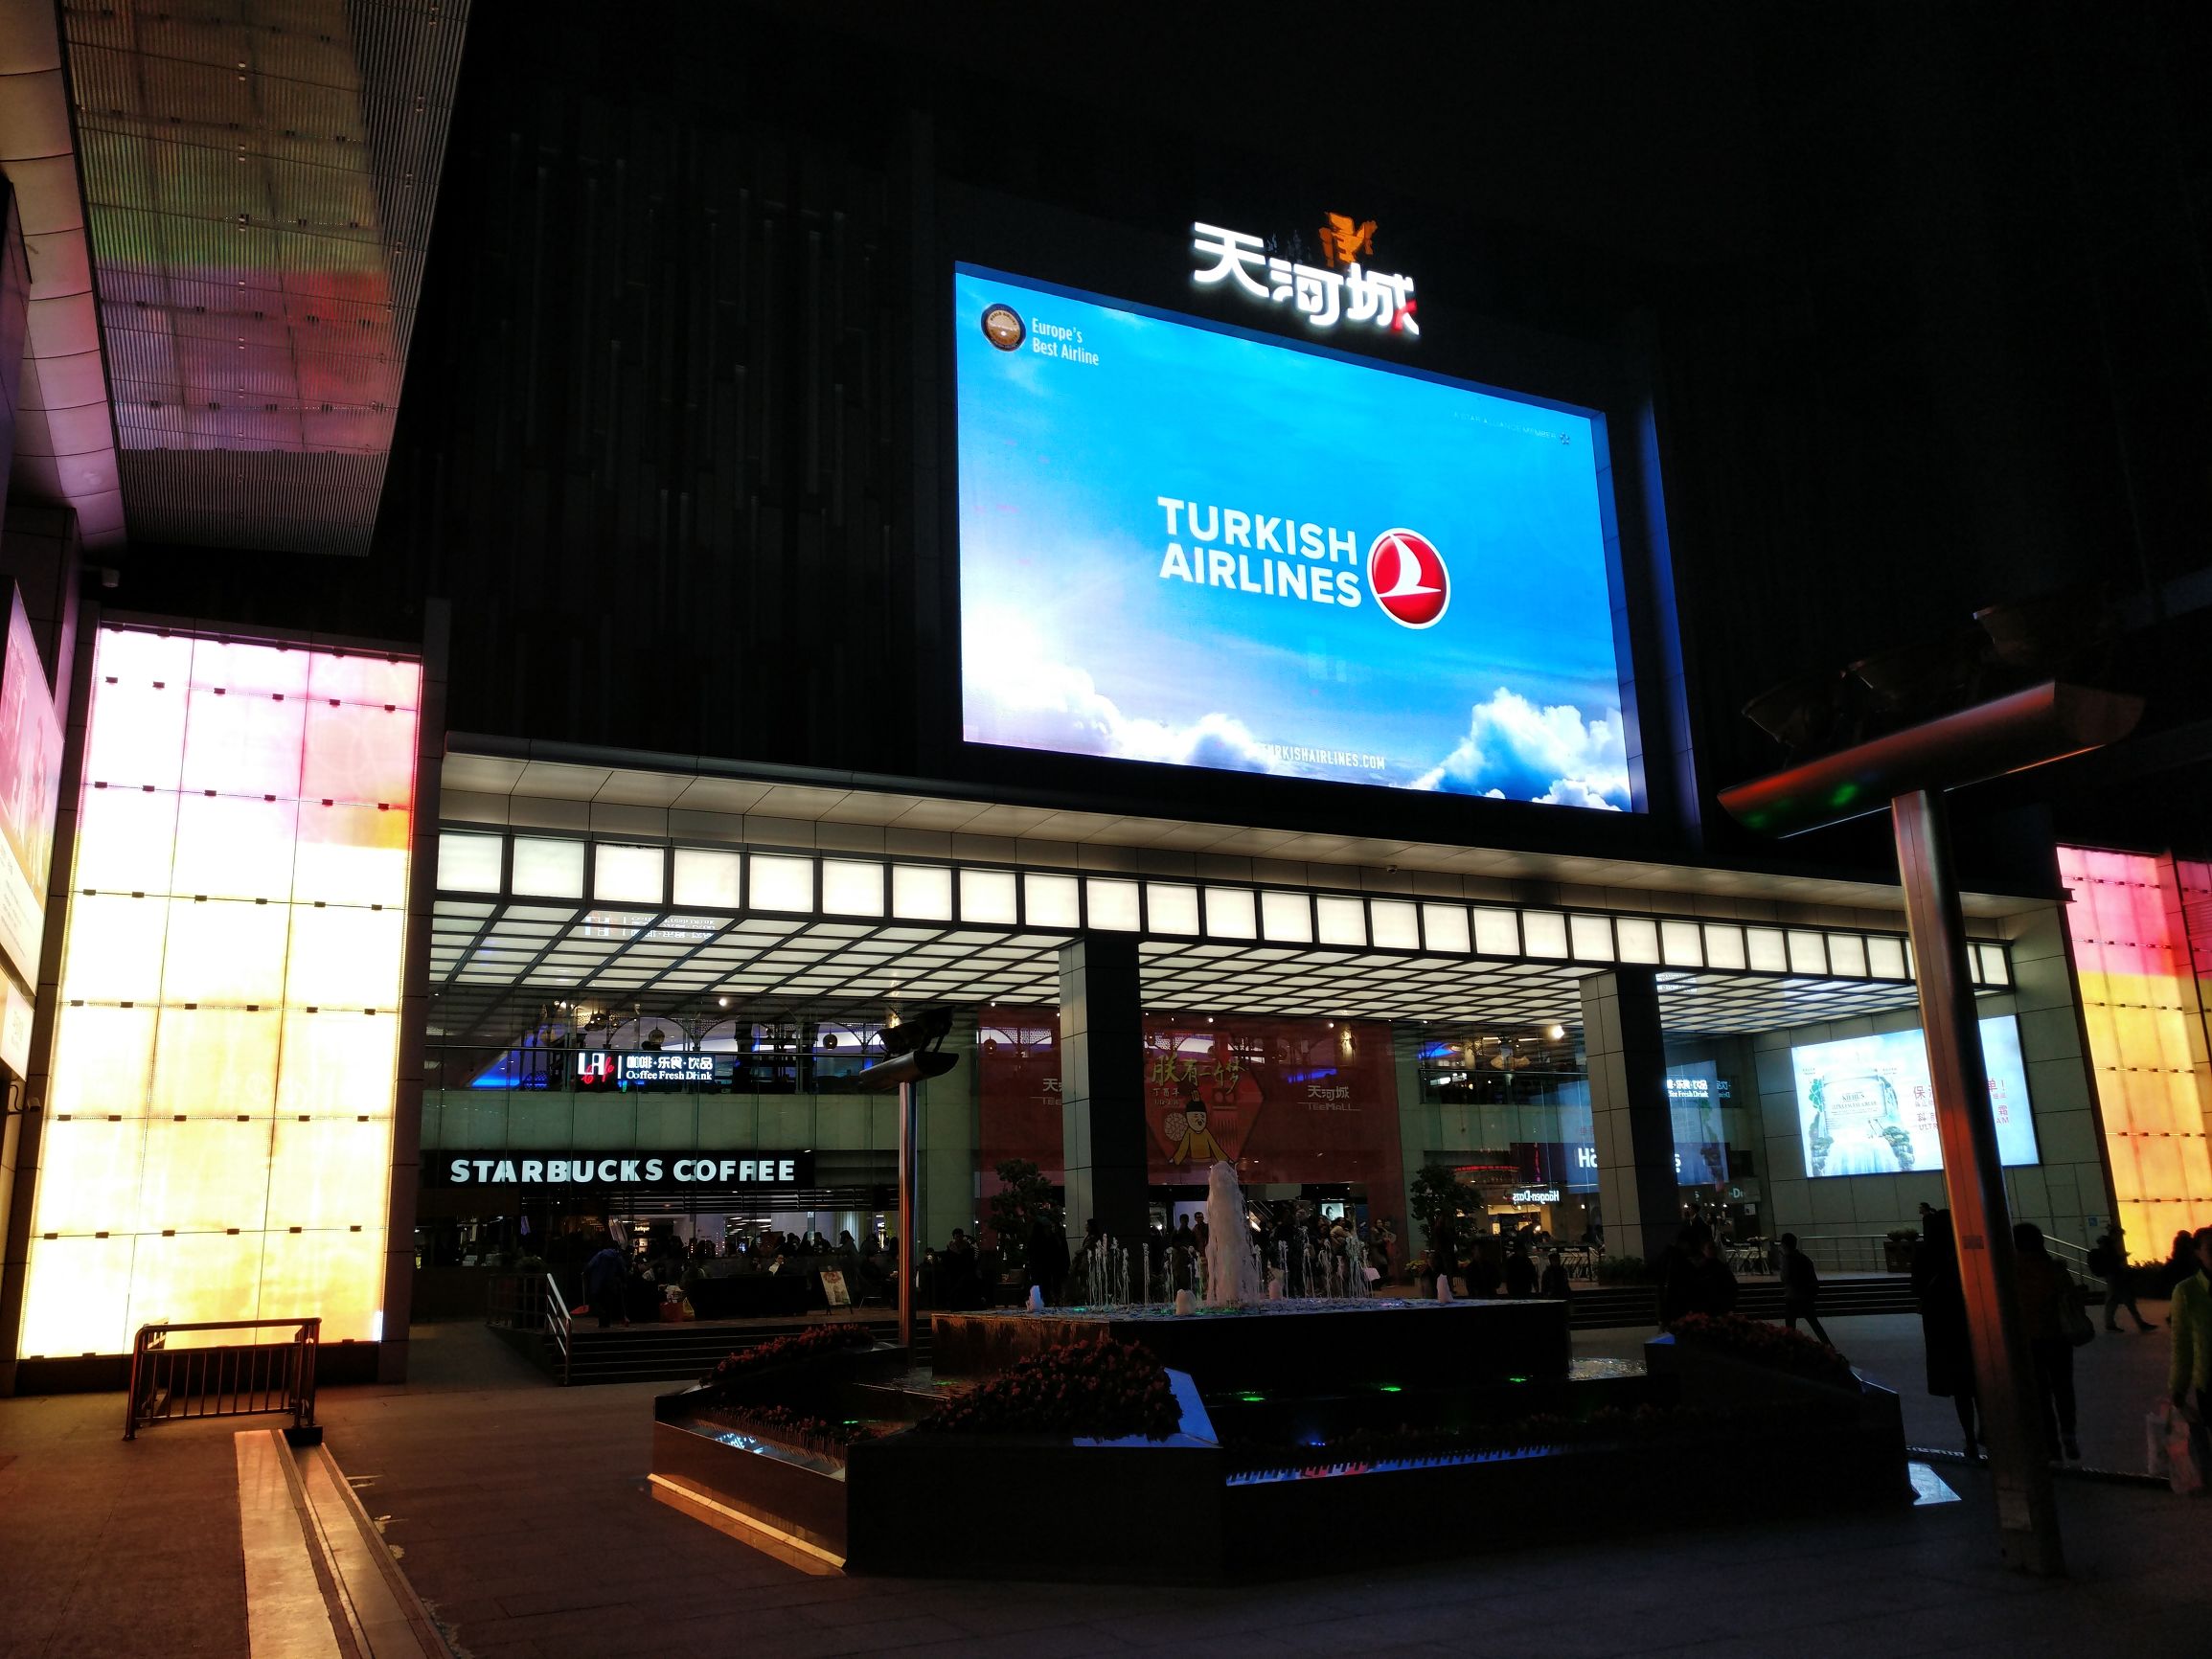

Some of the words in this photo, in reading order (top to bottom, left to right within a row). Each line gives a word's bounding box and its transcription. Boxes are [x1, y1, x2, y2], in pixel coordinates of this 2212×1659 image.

[1194, 221, 1421, 336] 天河城
[1032, 317, 1083, 344] Europe's
[1032, 337, 1059, 357] Best
[1060, 343, 1100, 366] Airline
[1157, 495, 1357, 565] TURKISH
[1159, 542, 1362, 608] AIRLINES
[658, 1070, 685, 1080] Fresh
[1307, 1084, 1350, 1102] 天河城
[450, 1159, 663, 1183] STARBUCKS
[673, 1159, 795, 1182] COFFEE
